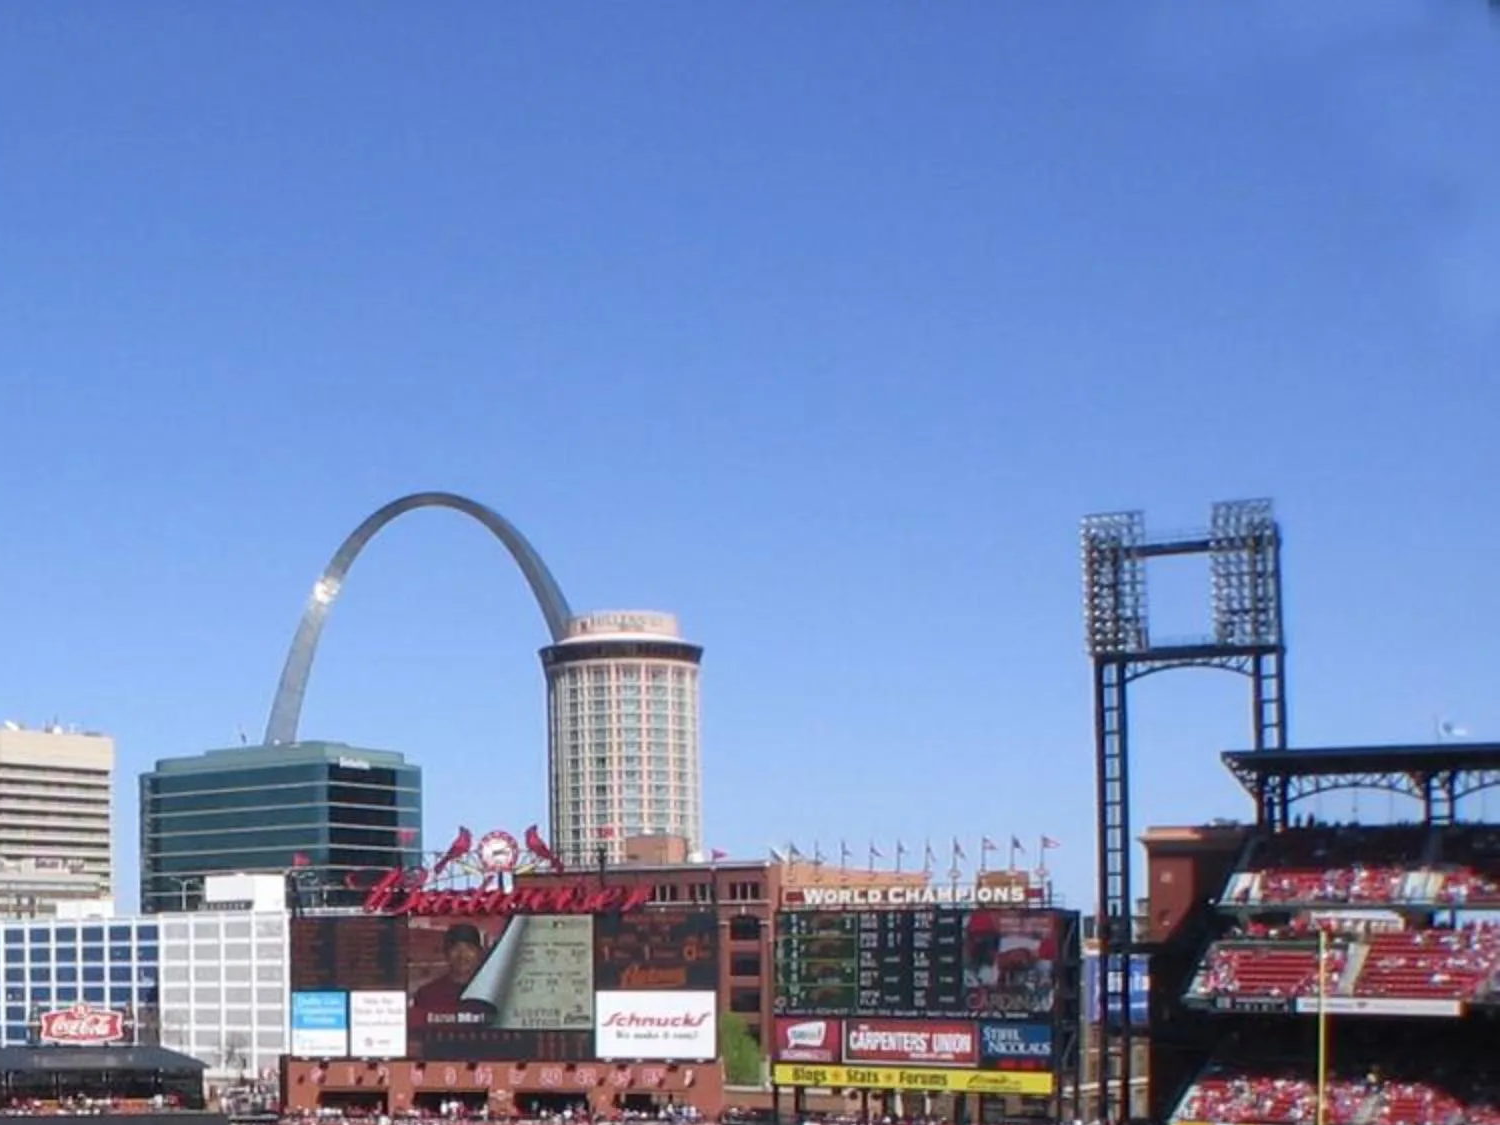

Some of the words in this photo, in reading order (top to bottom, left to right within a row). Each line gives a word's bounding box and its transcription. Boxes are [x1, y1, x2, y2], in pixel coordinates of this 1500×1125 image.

[803, 887, 881, 905] WORLD
[888, 885, 1025, 904] CHAMPIONS
[601, 1011, 712, 1028] Schnucks
[849, 1030, 931, 1053] CARPENTERS'
[932, 1033, 972, 1053] UNION
[987, 1039, 1053, 1056] NICOLAUS
[792, 1067, 826, 1086] Blogs
[846, 1069, 879, 1084] Stats
[899, 1071, 948, 1086] Forums
